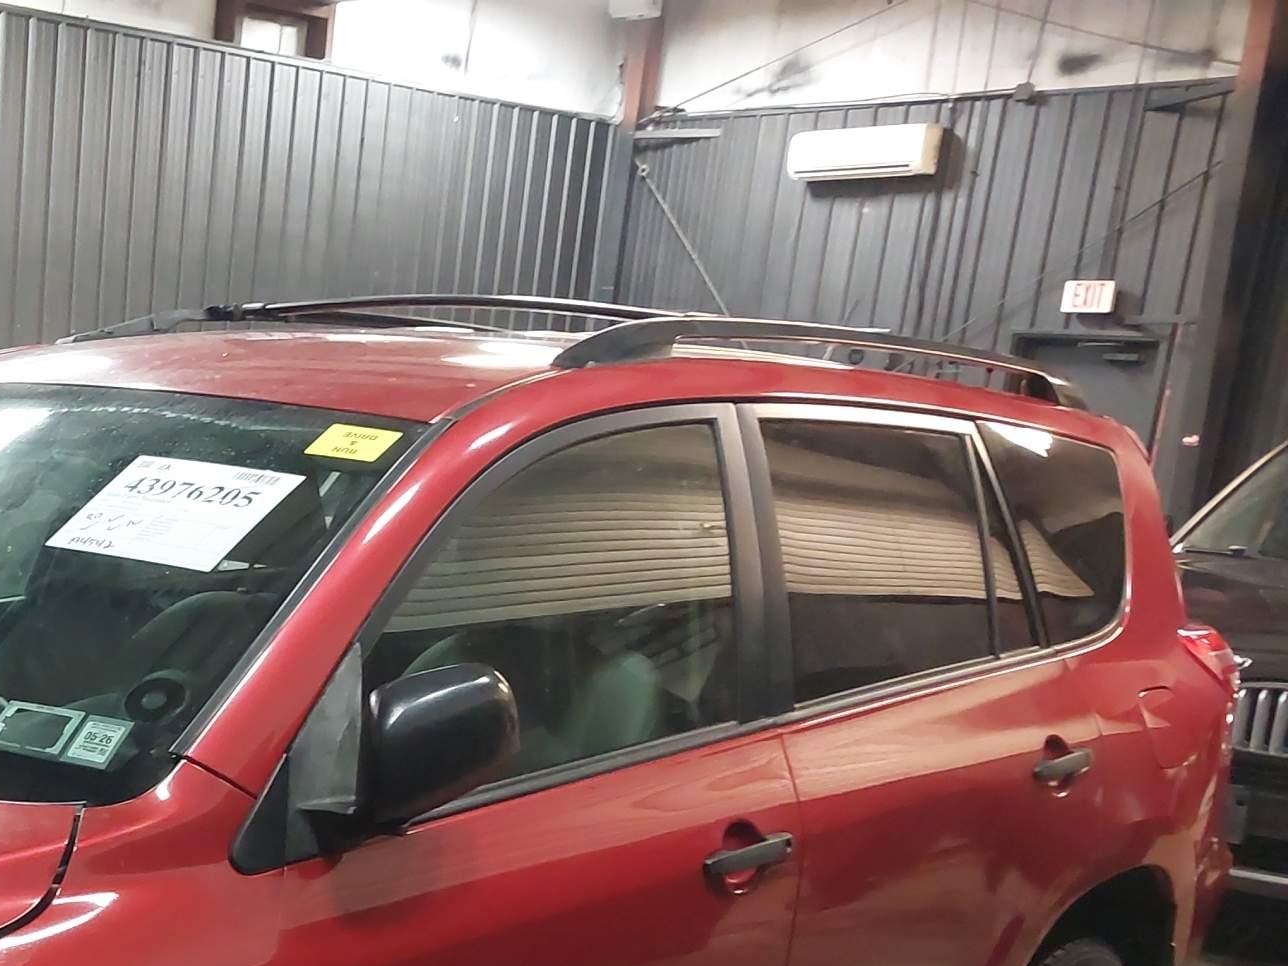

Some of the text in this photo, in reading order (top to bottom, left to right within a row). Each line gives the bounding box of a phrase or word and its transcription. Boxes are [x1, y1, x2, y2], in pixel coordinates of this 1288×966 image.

[1070, 281, 1107, 308] EXIT
[342, 431, 380, 441] DRIVE
[331, 446, 359, 455] RUN
[123, 476, 262, 508] 43976205
